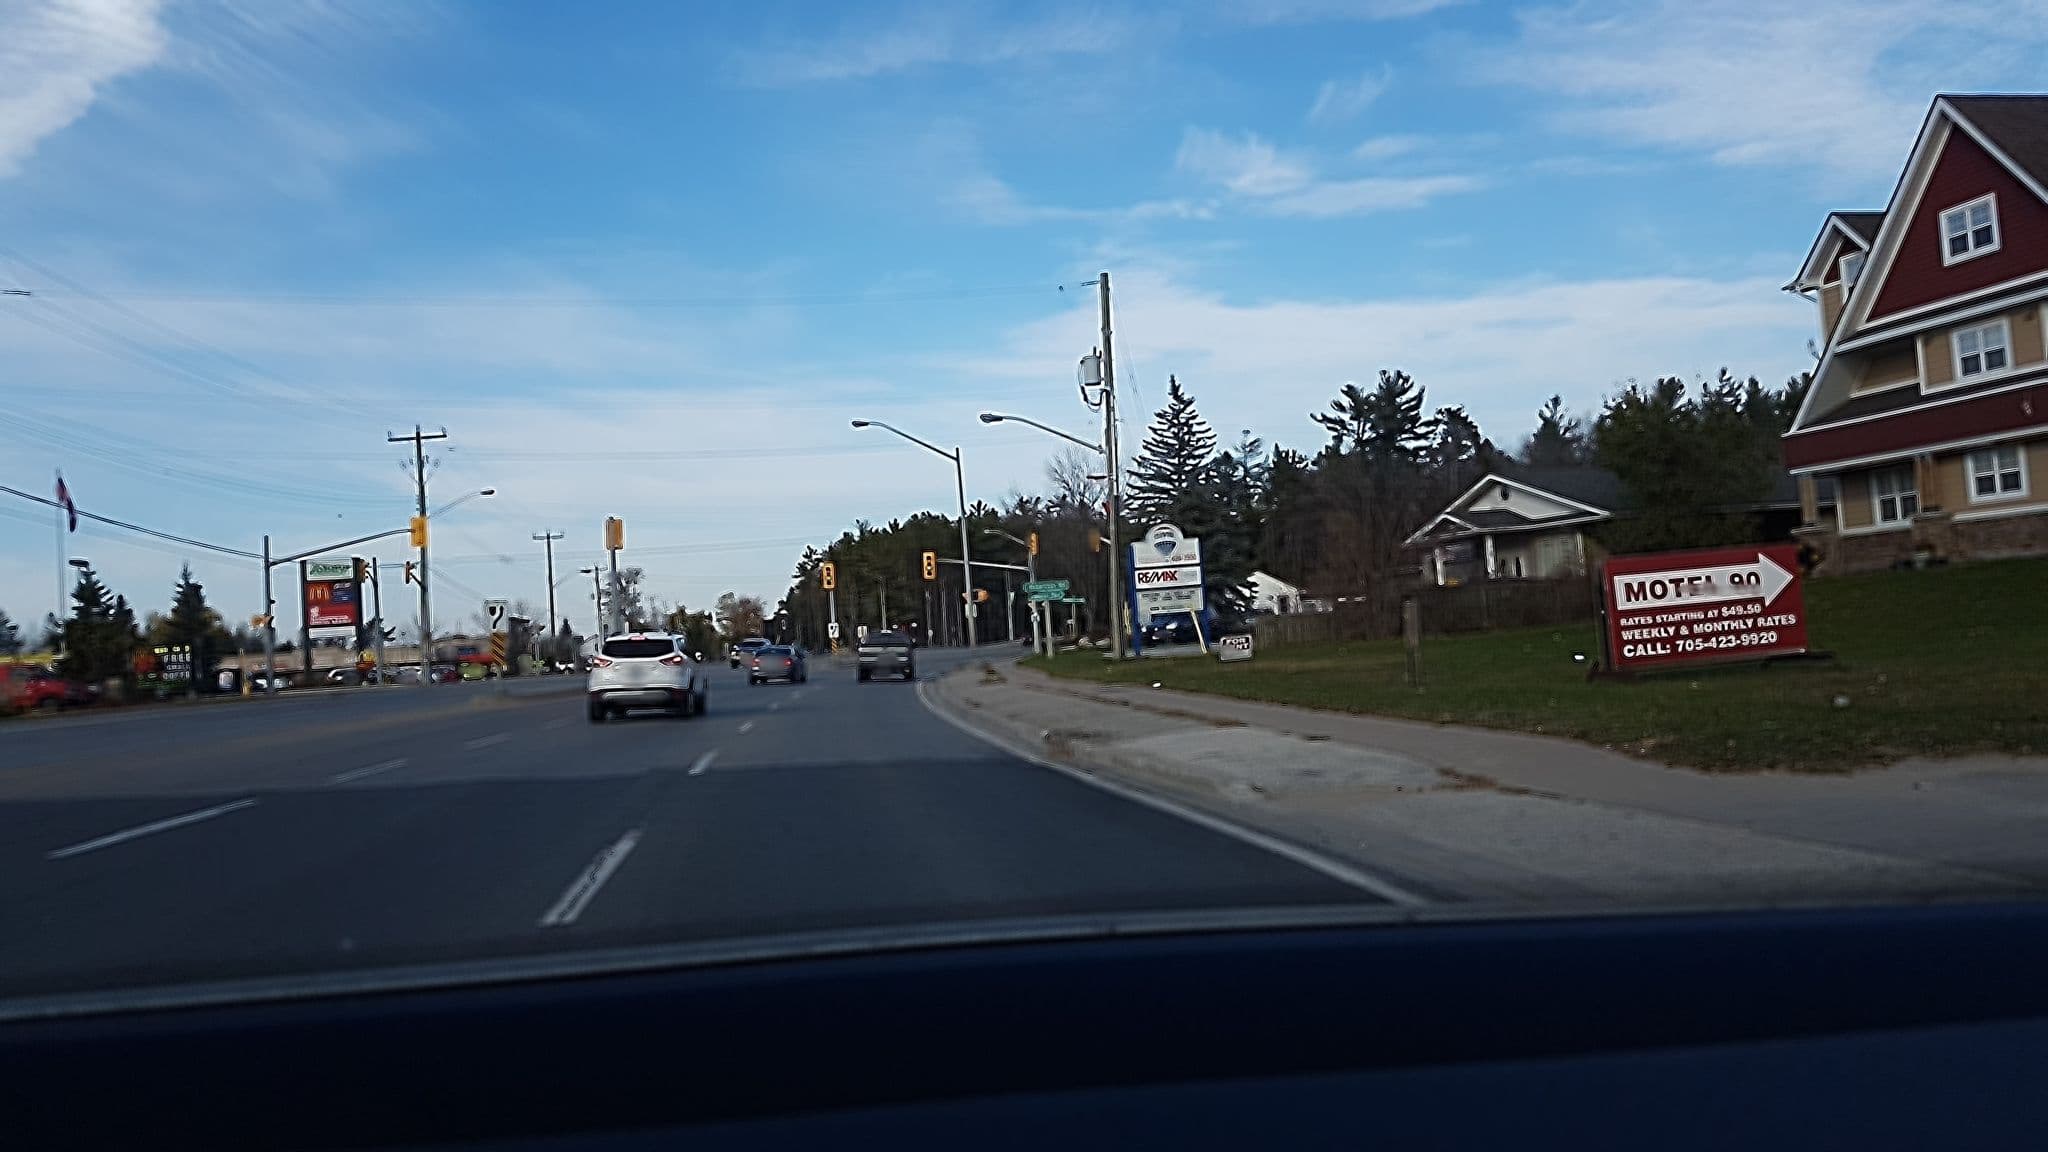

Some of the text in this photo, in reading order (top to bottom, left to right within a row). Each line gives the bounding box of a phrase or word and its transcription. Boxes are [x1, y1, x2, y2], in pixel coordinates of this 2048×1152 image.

[1137, 570, 1178, 585] RE/MAX
[1620, 603, 1762, 626] RATES STARTING AT $49.50
[1621, 613, 1796, 641] WEEKLY & MONTHLY RATES
[1623, 630, 1778, 658] CALL: 705-423-9920
